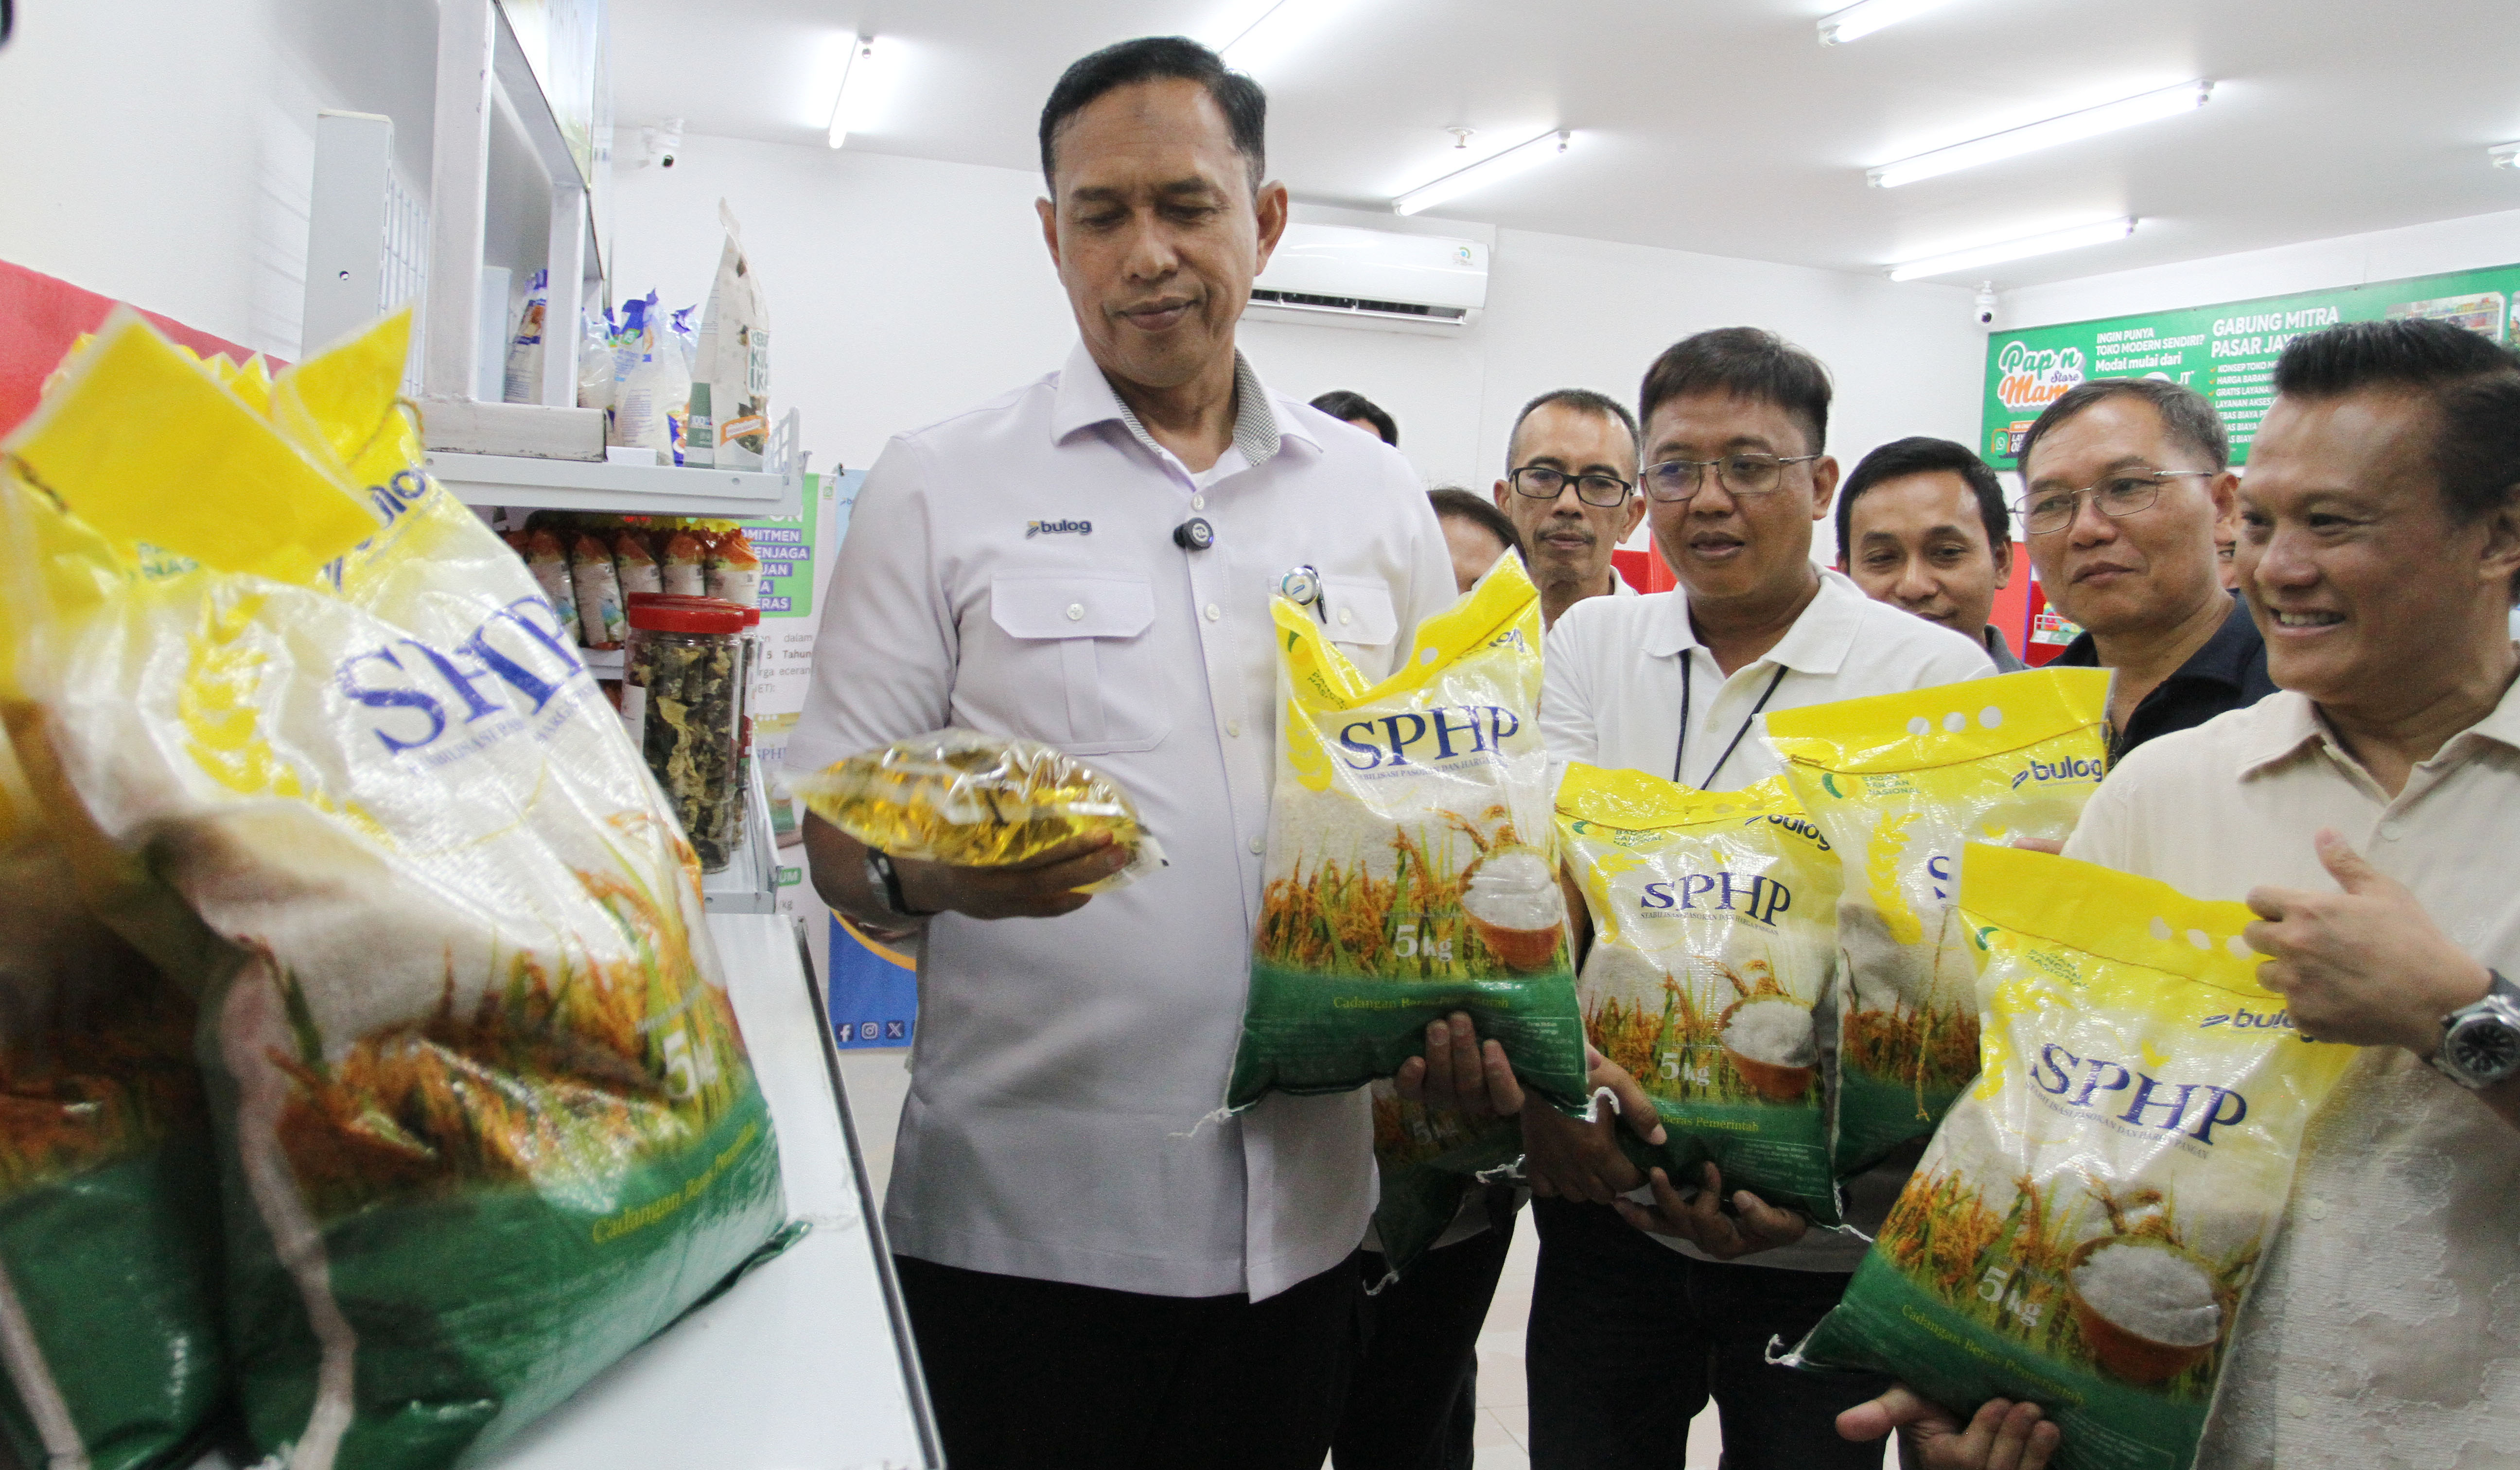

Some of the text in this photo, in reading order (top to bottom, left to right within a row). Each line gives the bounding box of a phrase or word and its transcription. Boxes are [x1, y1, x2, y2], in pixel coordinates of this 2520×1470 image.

[2212, 306, 2340, 337] GABUNG MITRA
[2097, 327, 2155, 344] INGIN PUNYA
[2096, 334, 2206, 356] TOKO MODERN SENDIRI?
[2211, 333, 2297, 358] PASAR JAY
[2095, 351, 2182, 372] Modal mulai dari
[2218, 363, 2247, 373] KONSEP
[2247, 361, 2267, 371] TOKO
[2050, 370, 2079, 383] Store
[2217, 375, 2242, 385] HARGA
[2216, 387, 2241, 397] GRATIS
[2215, 397, 2272, 408] LAYANAN AKSES
[2237, 410, 2258, 419] BIAYA
[2237, 422, 2258, 431] BIAYA
[2237, 434, 2254, 443] BIAY
[1041, 520, 1092, 534] bulog
[754, 546, 806, 559] ENJAGA
[756, 598, 788, 610] ERAS
[784, 633, 813, 642] dalam
[783, 649, 812, 659] Tahun
[758, 668, 774, 679] rga
[1339, 705, 1519, 770] SPHP
[2030, 756, 2103, 783] bulog
[1640, 872, 1791, 927] SPHP
[1394, 924, 1453, 962] 5 kg
[1333, 996, 1397, 1011] Cadangan
[1658, 1052, 1711, 1086] 5 kg
[2030, 1042, 2248, 1145] SPHP
[1662, 1113, 1759, 1132] Beras Pemerintah
[2139, 1130, 2167, 1141] HARG
[1978, 1266, 2042, 1328] 5 kg
